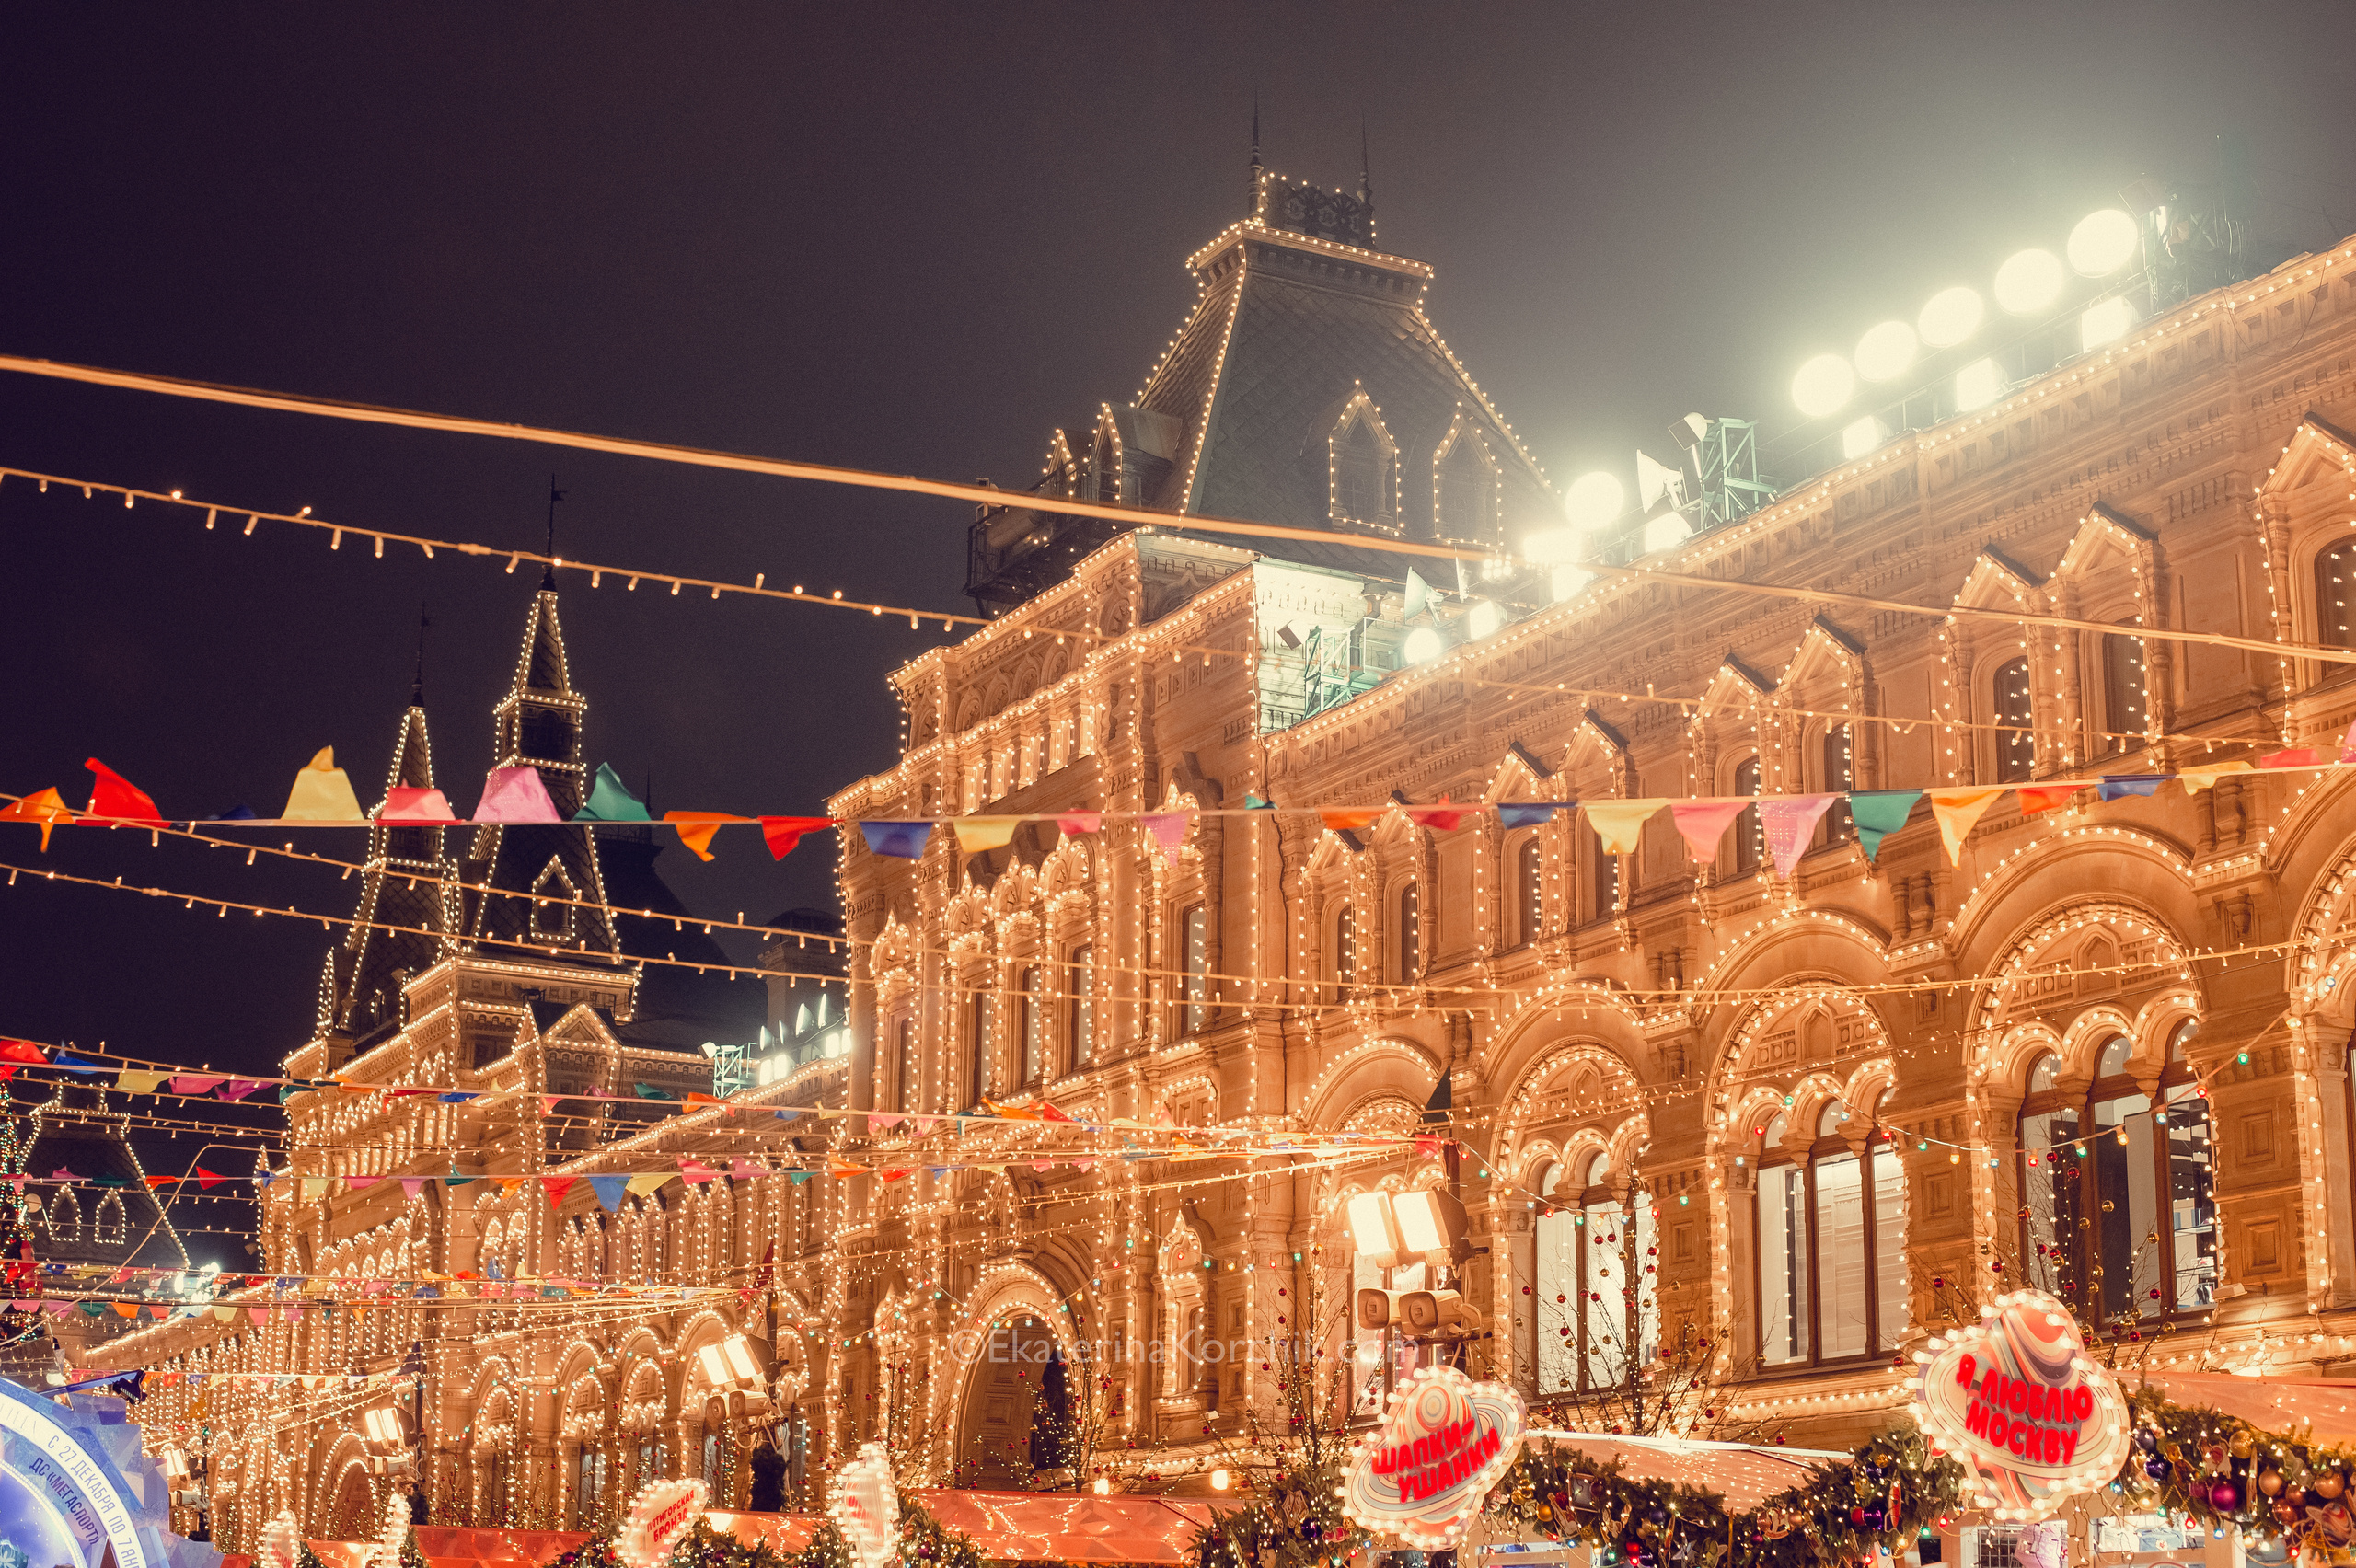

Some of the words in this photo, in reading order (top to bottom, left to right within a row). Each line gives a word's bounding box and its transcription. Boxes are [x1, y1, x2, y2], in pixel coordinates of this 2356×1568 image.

[1957, 1354, 1976, 1389] Я
[1981, 1368, 2093, 1424] ЛЮБЛЮ
[48, 1435, 59, 1448] С
[59, 1446, 77, 1462] 27
[1371, 1419, 1475, 1474] ШАПКИ-
[1965, 1400, 2078, 1465] МОСКВУ
[71, 1460, 115, 1513] ДЕКАБРЯ
[1398, 1427, 1501, 1504] УШАНКИ
[29, 1458, 50, 1476] ДС
[47, 1472, 99, 1545] «МЕГАСПОРТ»
[647, 1489, 694, 1532] ПЯТИГОРСКАЯ
[108, 1515, 126, 1534] ПО
[118, 1537, 132, 1545] 7
[653, 1508, 687, 1542] БРОНЗА
[121, 1549, 140, 1568] ЯН
